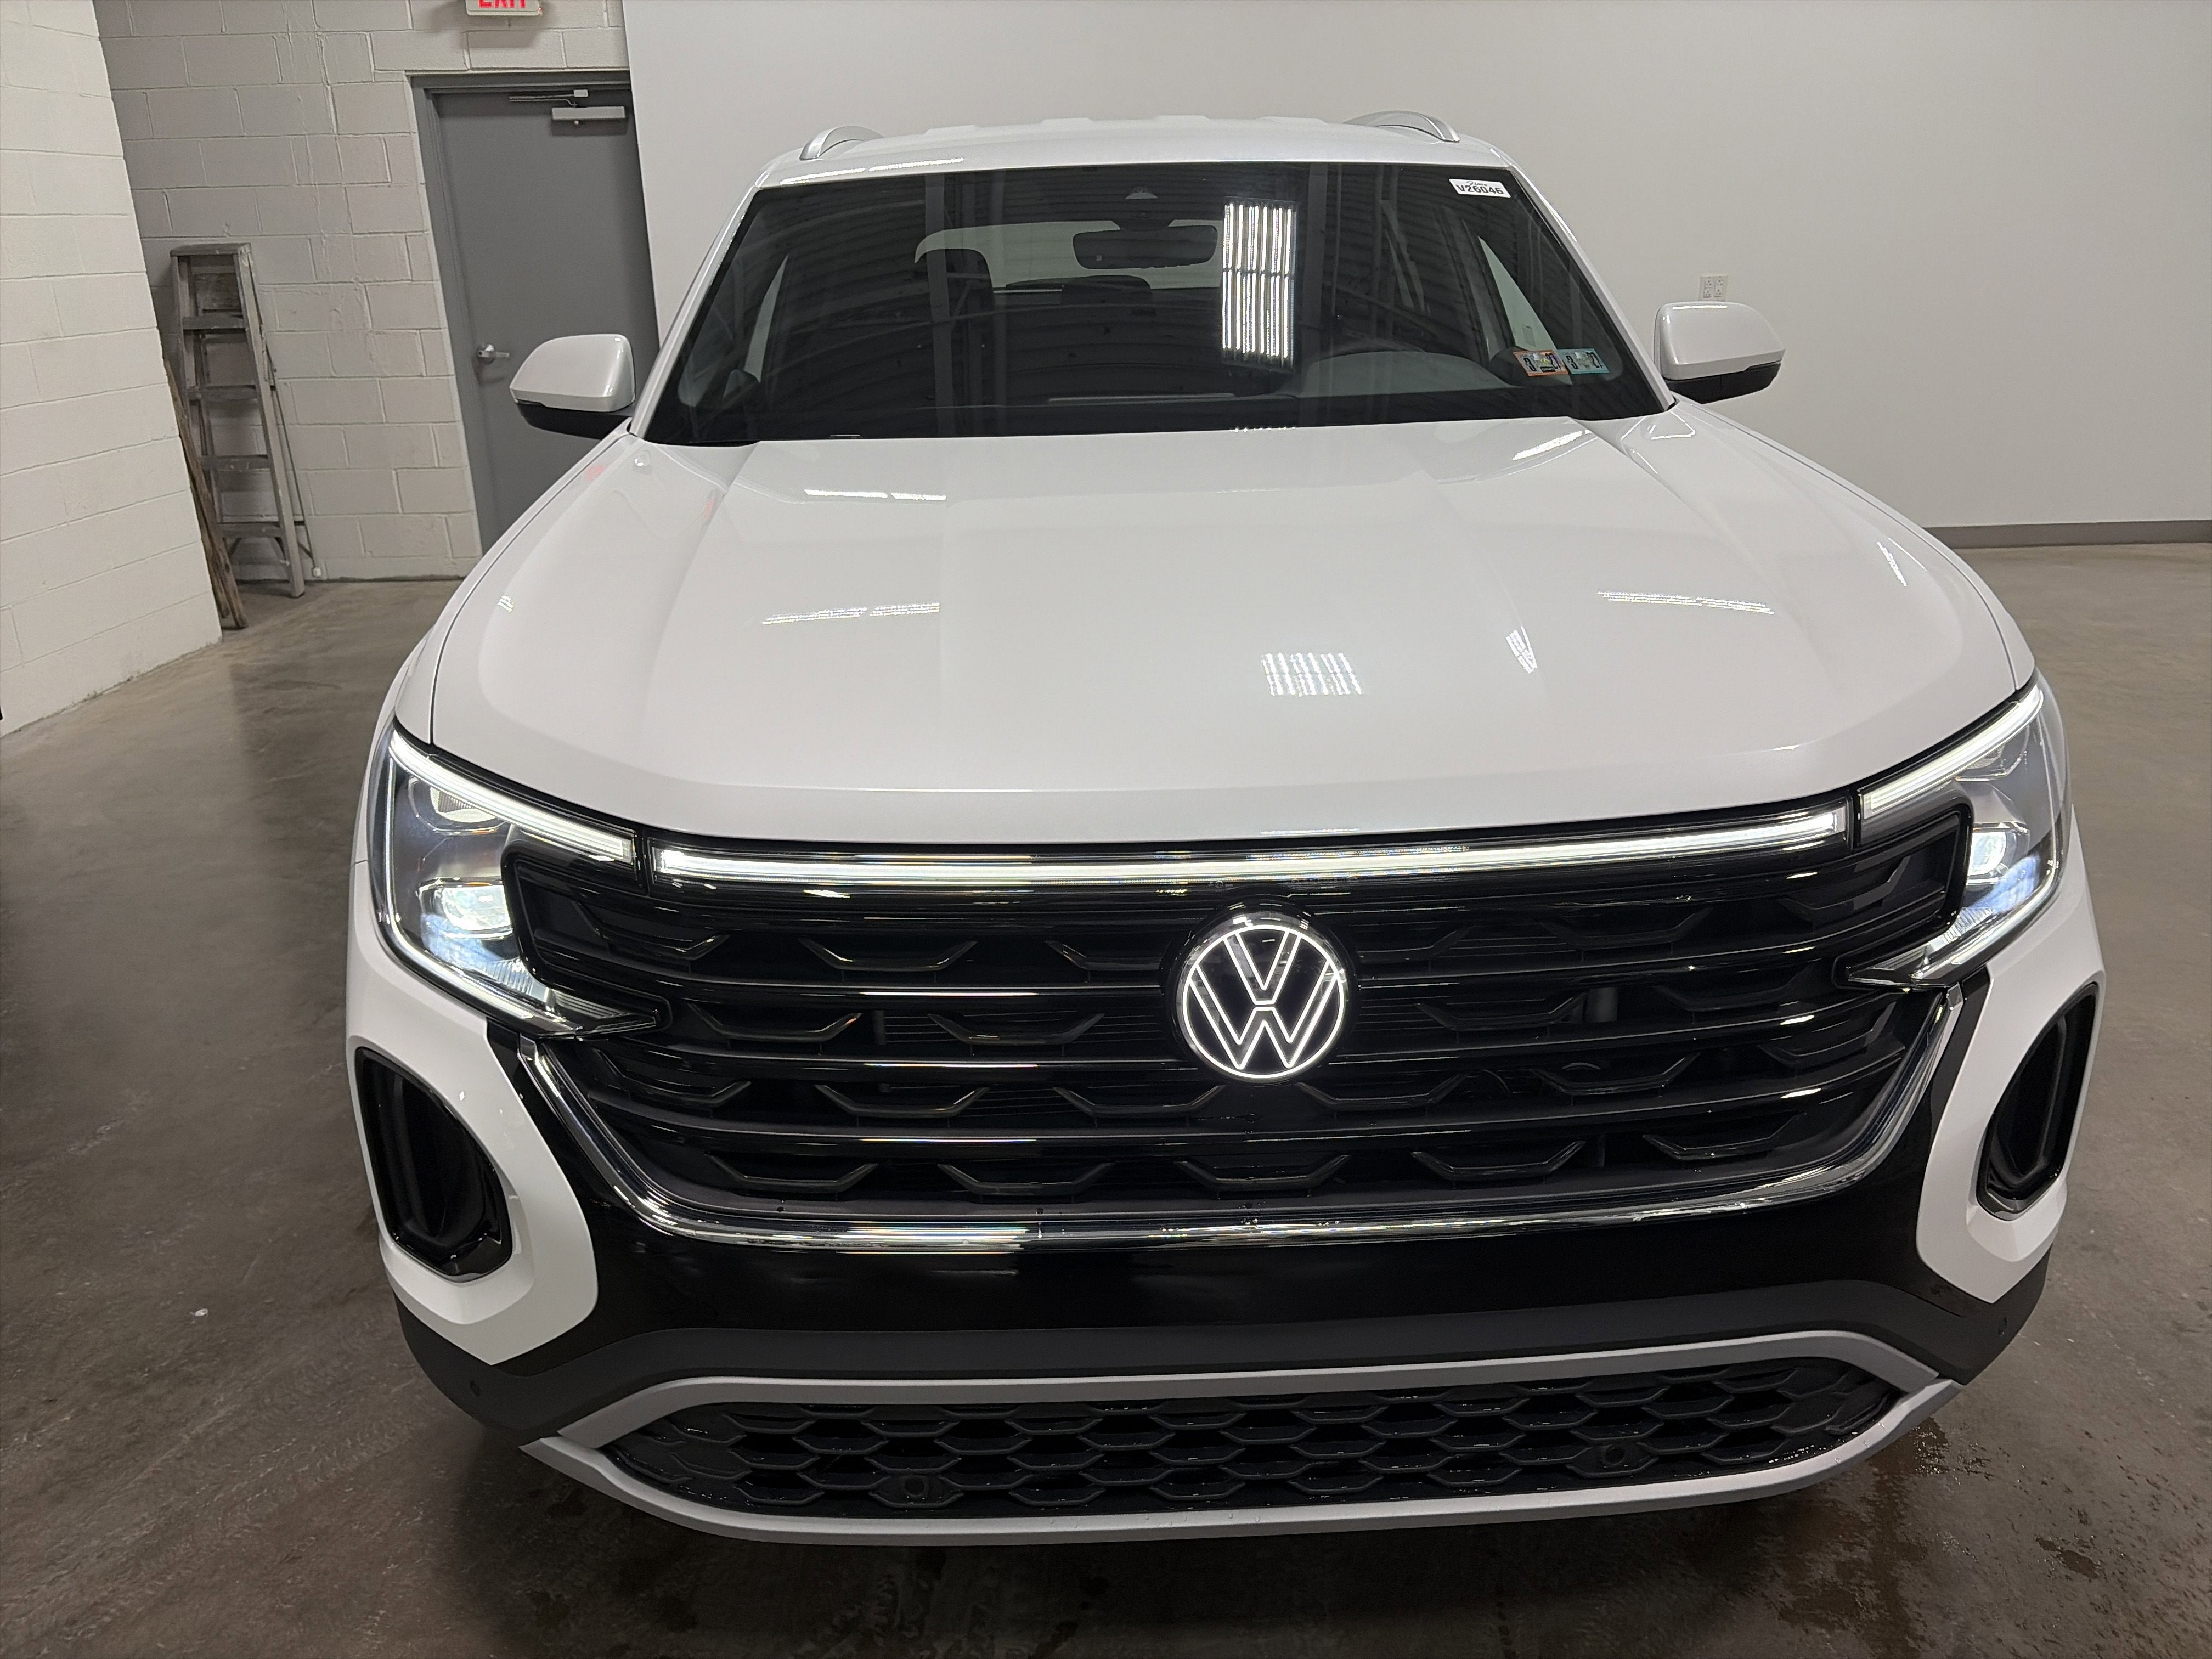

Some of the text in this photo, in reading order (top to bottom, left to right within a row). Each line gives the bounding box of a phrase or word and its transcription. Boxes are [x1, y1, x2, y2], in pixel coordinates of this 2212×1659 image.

[1456, 184, 1504, 194] V26046
[1523, 358, 1537, 372] 3
[1566, 355, 1579, 370] 3
